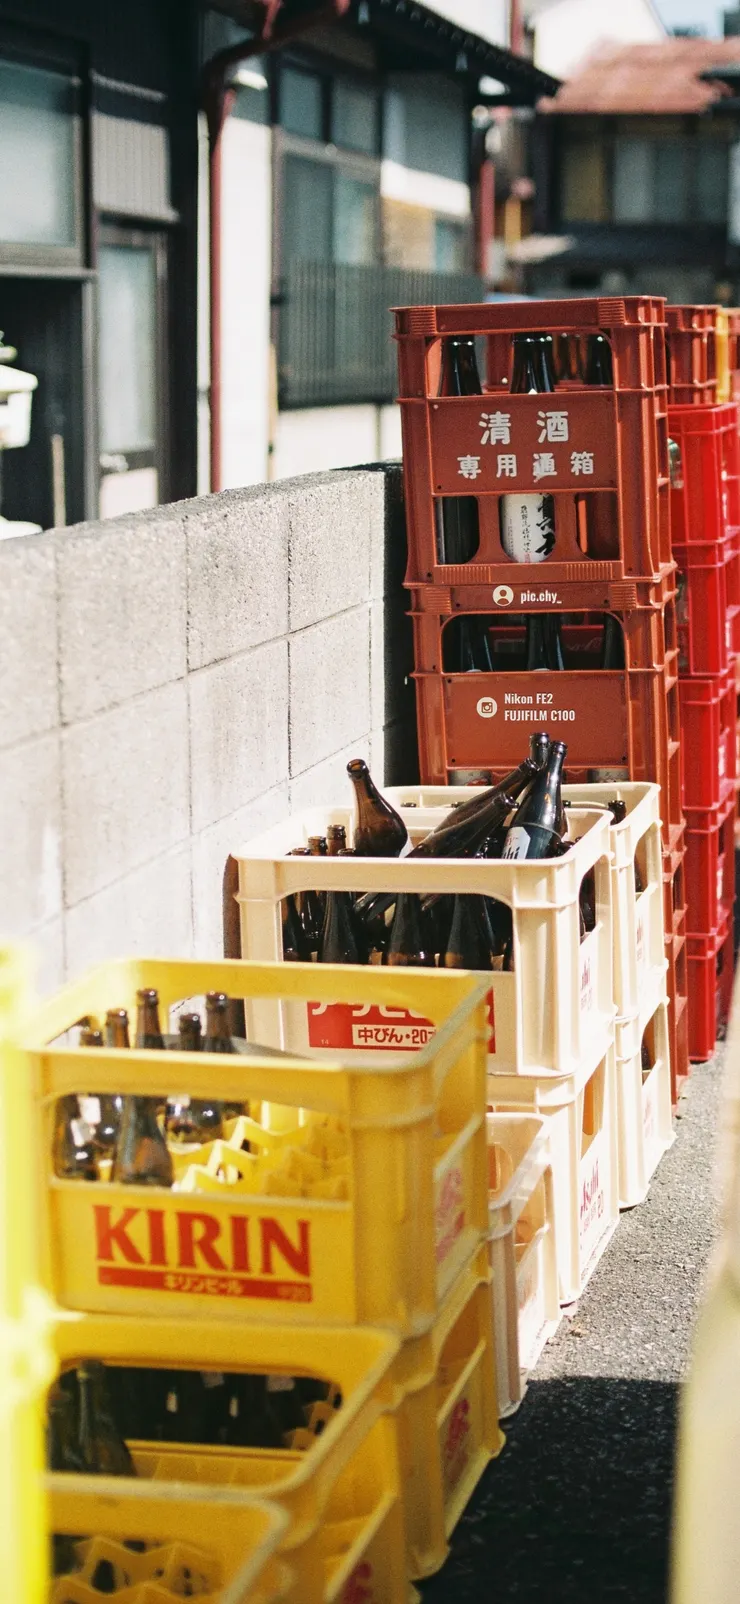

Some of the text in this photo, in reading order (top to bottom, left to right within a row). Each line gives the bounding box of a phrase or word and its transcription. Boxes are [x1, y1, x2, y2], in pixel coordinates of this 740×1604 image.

[478, 410, 569, 446] 清酒
[93, 1204, 311, 1278] KIRIN
[163, 1272, 244, 1295] キリンビール
